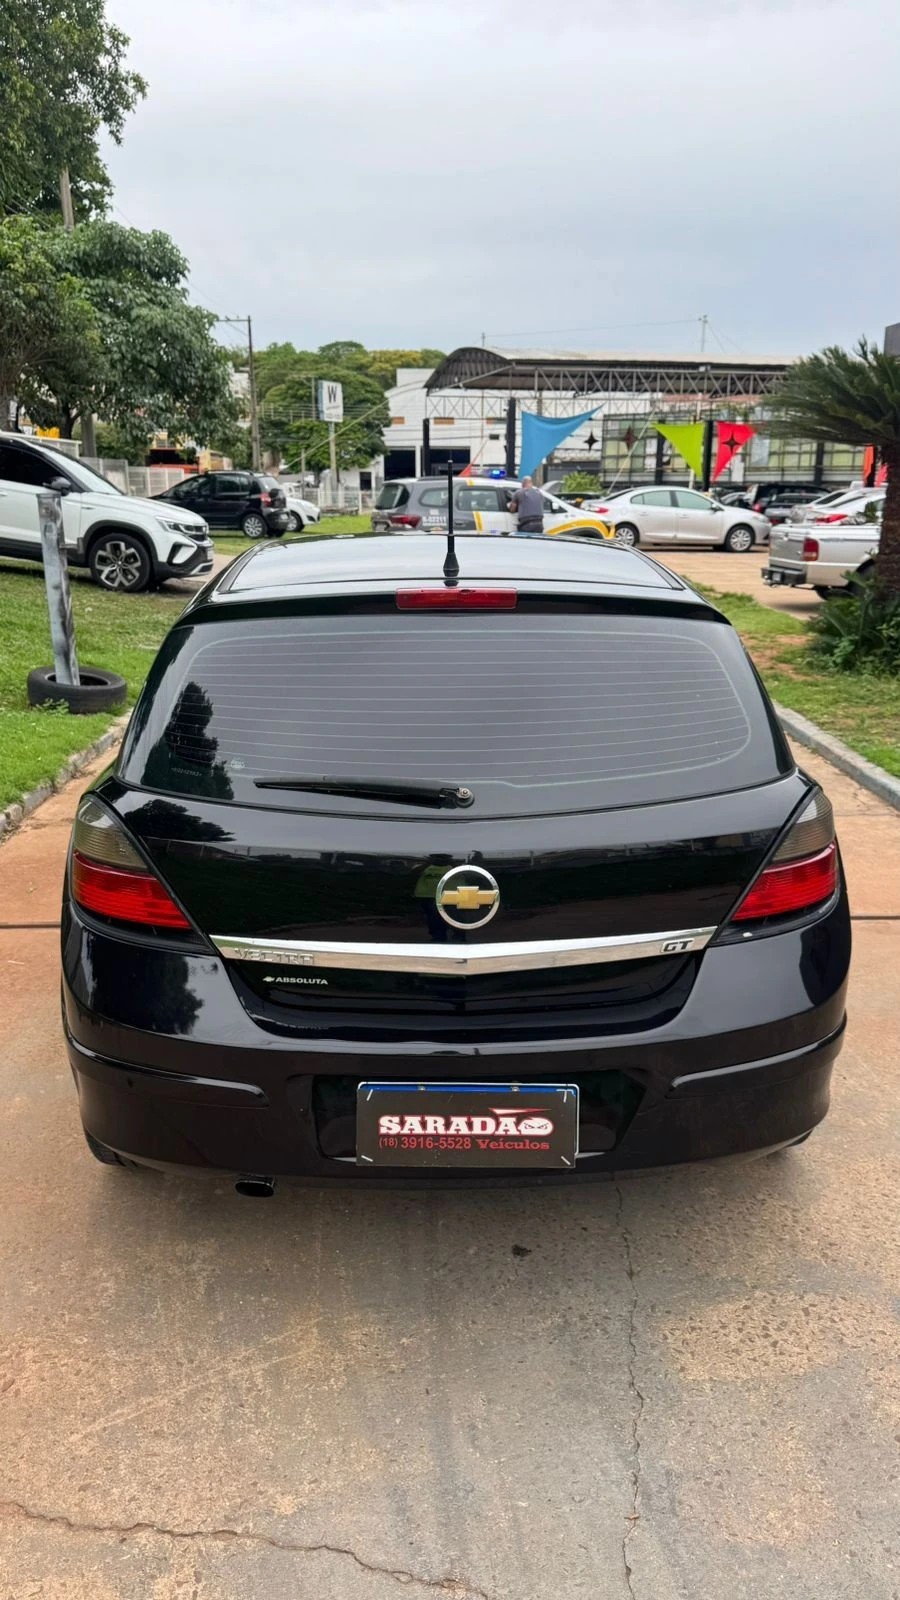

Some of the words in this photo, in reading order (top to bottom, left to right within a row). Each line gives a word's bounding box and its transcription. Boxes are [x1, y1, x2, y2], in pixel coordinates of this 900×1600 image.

[327, 385, 338, 403] W
[662, 939, 694, 953] GT
[275, 976, 328, 985] ABSOLUTA
[379, 1138, 398, 1149] (18)
[402, 1136, 472, 1149] 3916-5528
